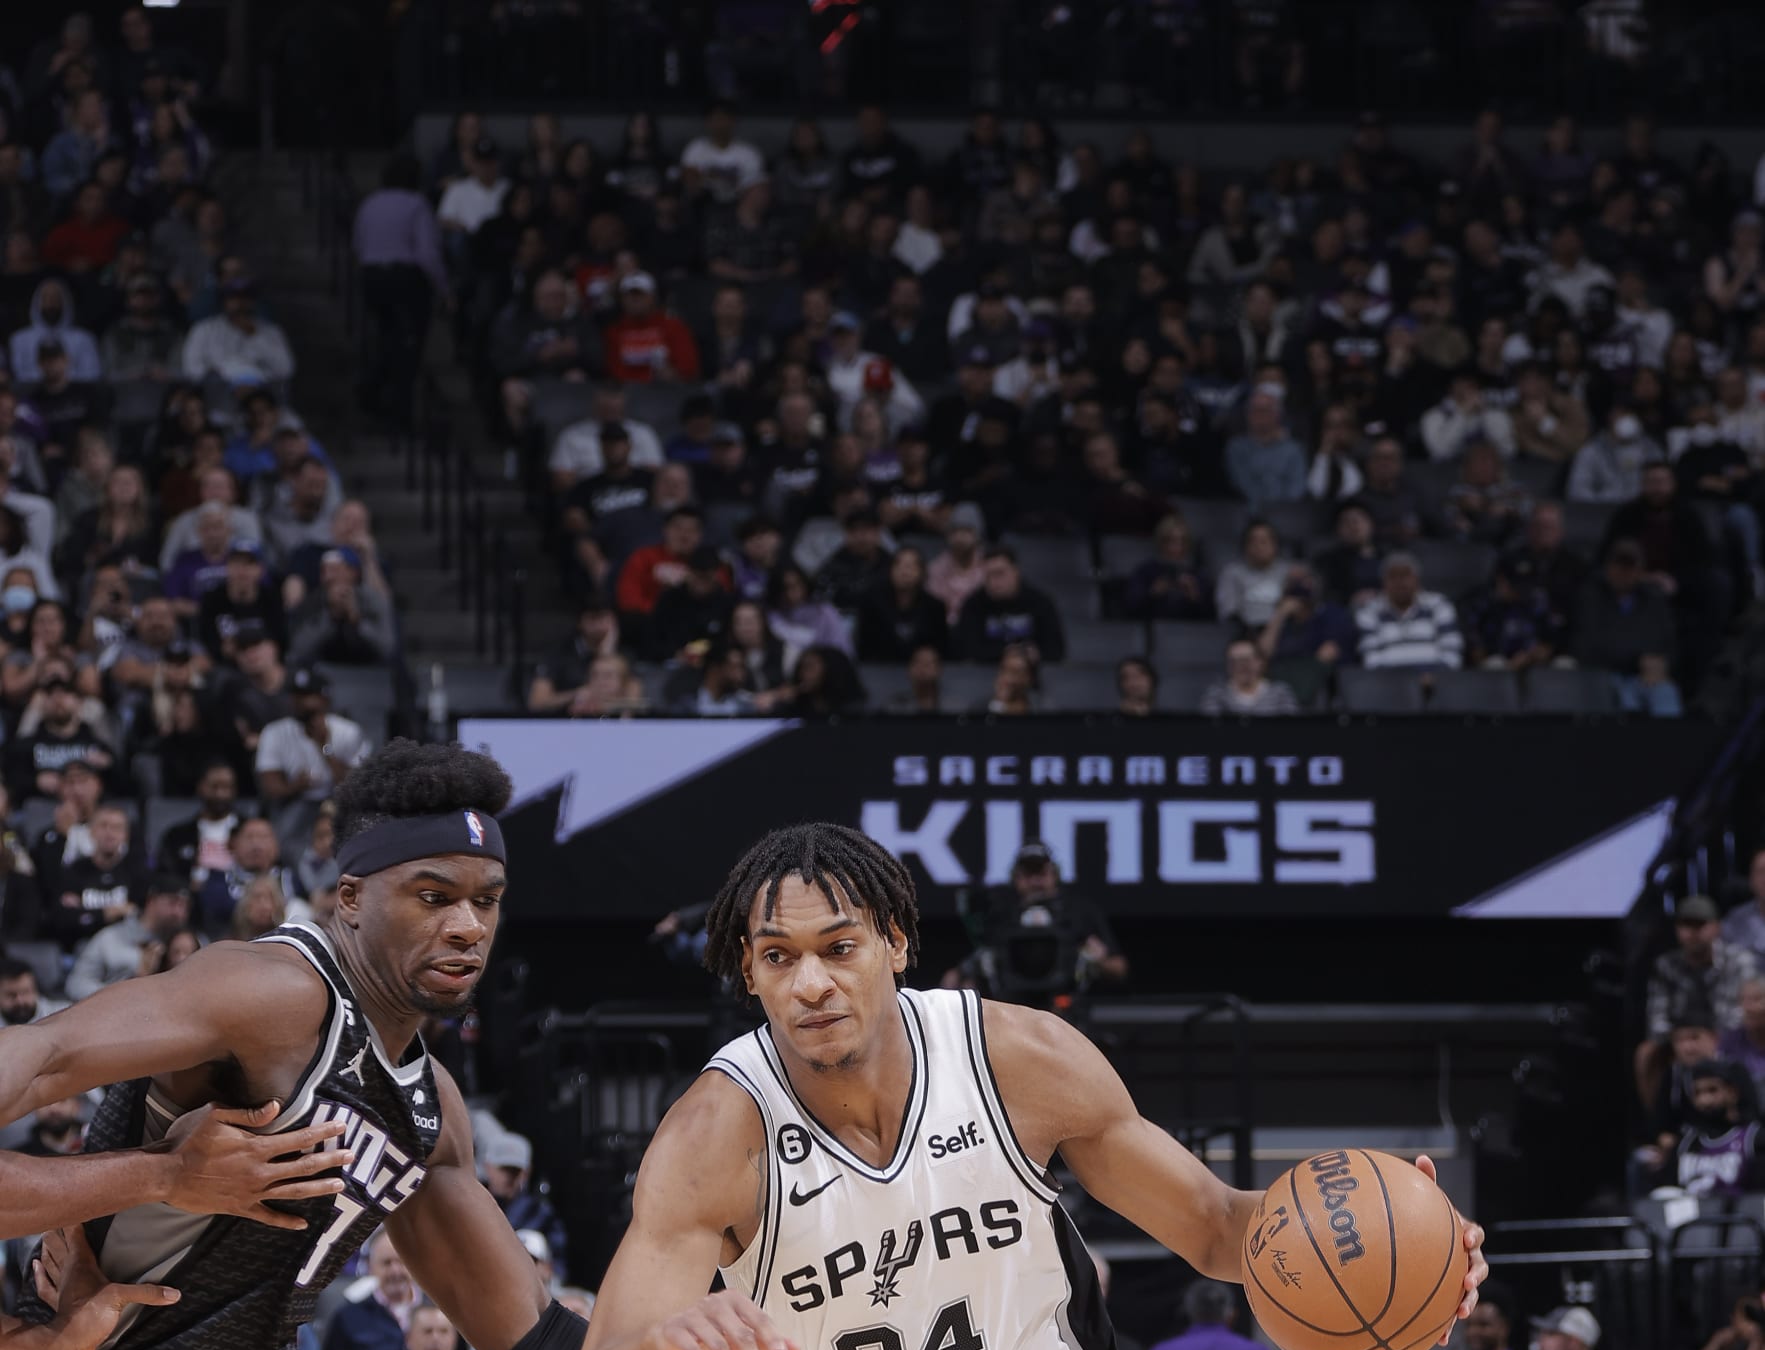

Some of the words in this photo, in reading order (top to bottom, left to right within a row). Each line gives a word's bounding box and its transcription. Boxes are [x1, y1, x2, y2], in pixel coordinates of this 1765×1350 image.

[893, 755, 1344, 786] SACRAMENTO
[860, 799, 1377, 886] KINGS
[779, 1127, 811, 1160] 6
[927, 1120, 986, 1160] Self.
[294, 1191, 368, 1287] 7
[780, 1198, 1023, 1313] SPURS
